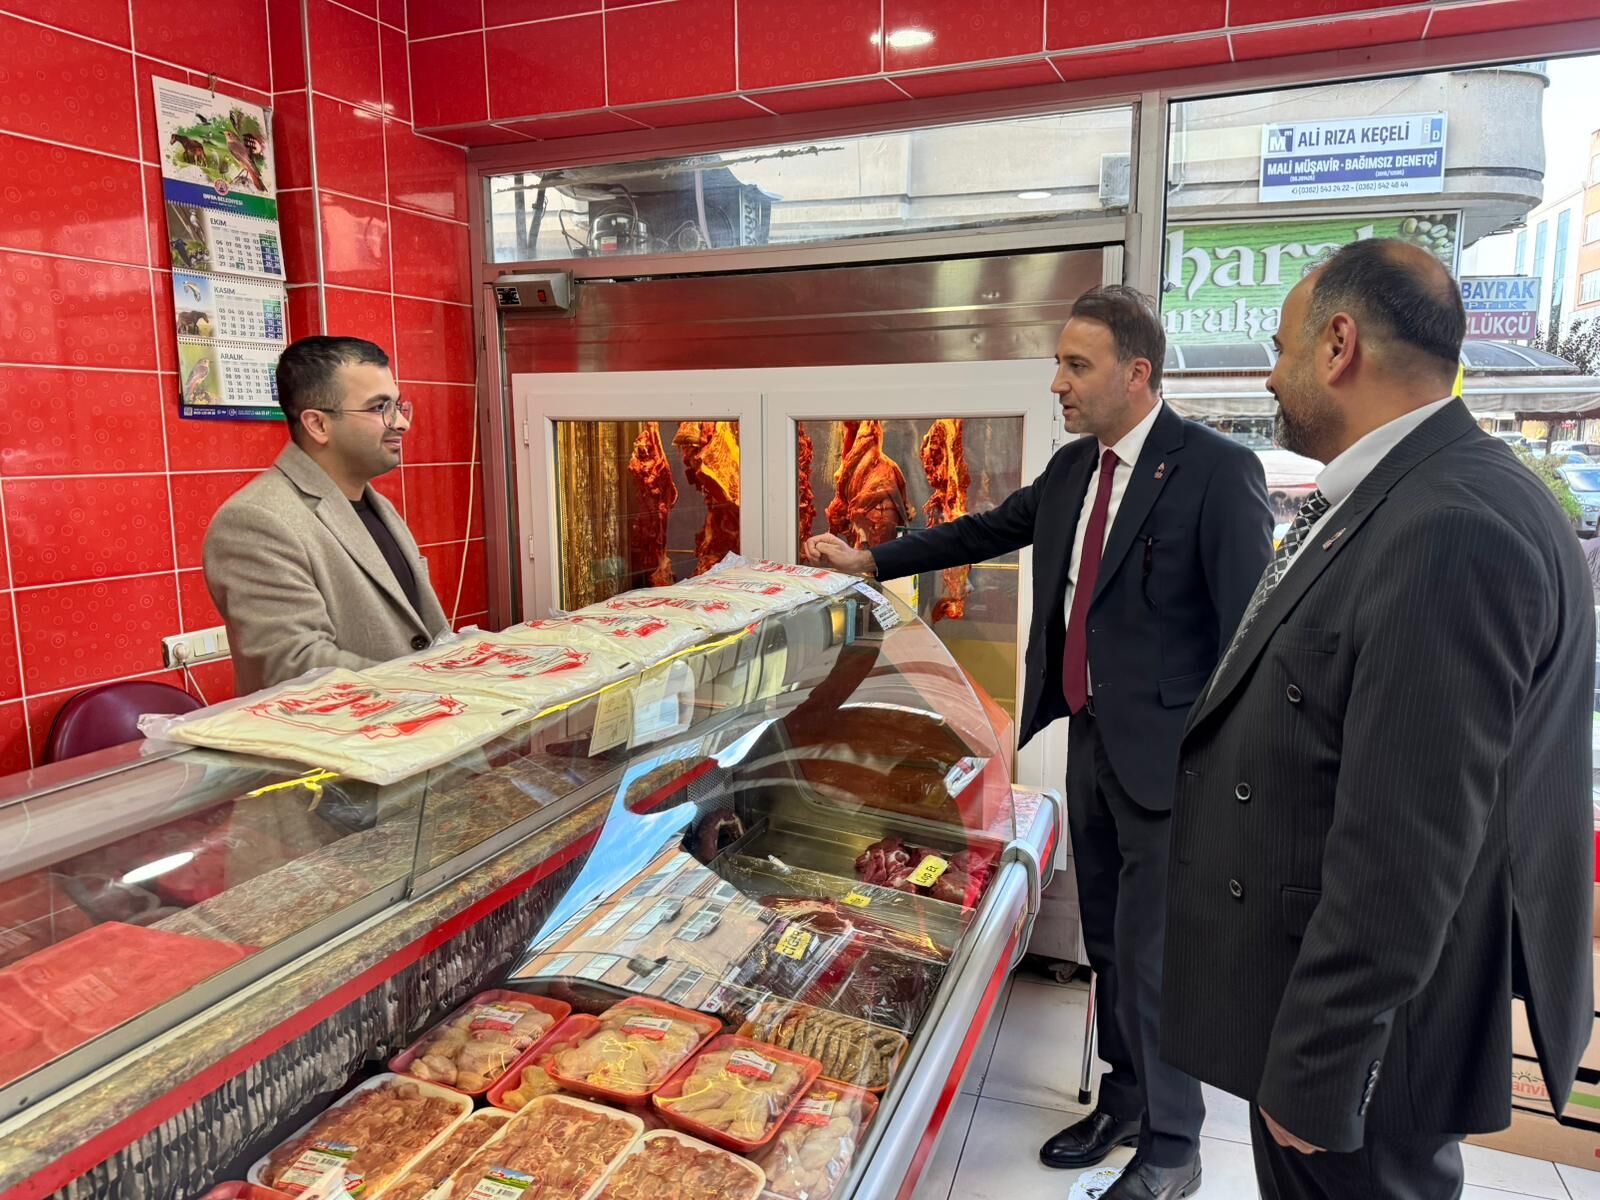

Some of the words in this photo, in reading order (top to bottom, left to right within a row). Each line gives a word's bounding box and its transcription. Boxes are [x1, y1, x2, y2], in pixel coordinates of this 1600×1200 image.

[1298, 127, 1319, 147] ALİ
[1325, 128, 1355, 145] RIZA
[1362, 121, 1409, 145] KEÇELİ
[1268, 159, 1292, 175] MALİ
[1295, 158, 1339, 174] MÜŞAVİR
[1345, 155, 1392, 170] BAĞIMSIZ
[1396, 151, 1437, 167] DENETÇİ
[1462, 281, 1535, 299] BAYRAK
[1466, 313, 1531, 336] LÜKÇÜ
